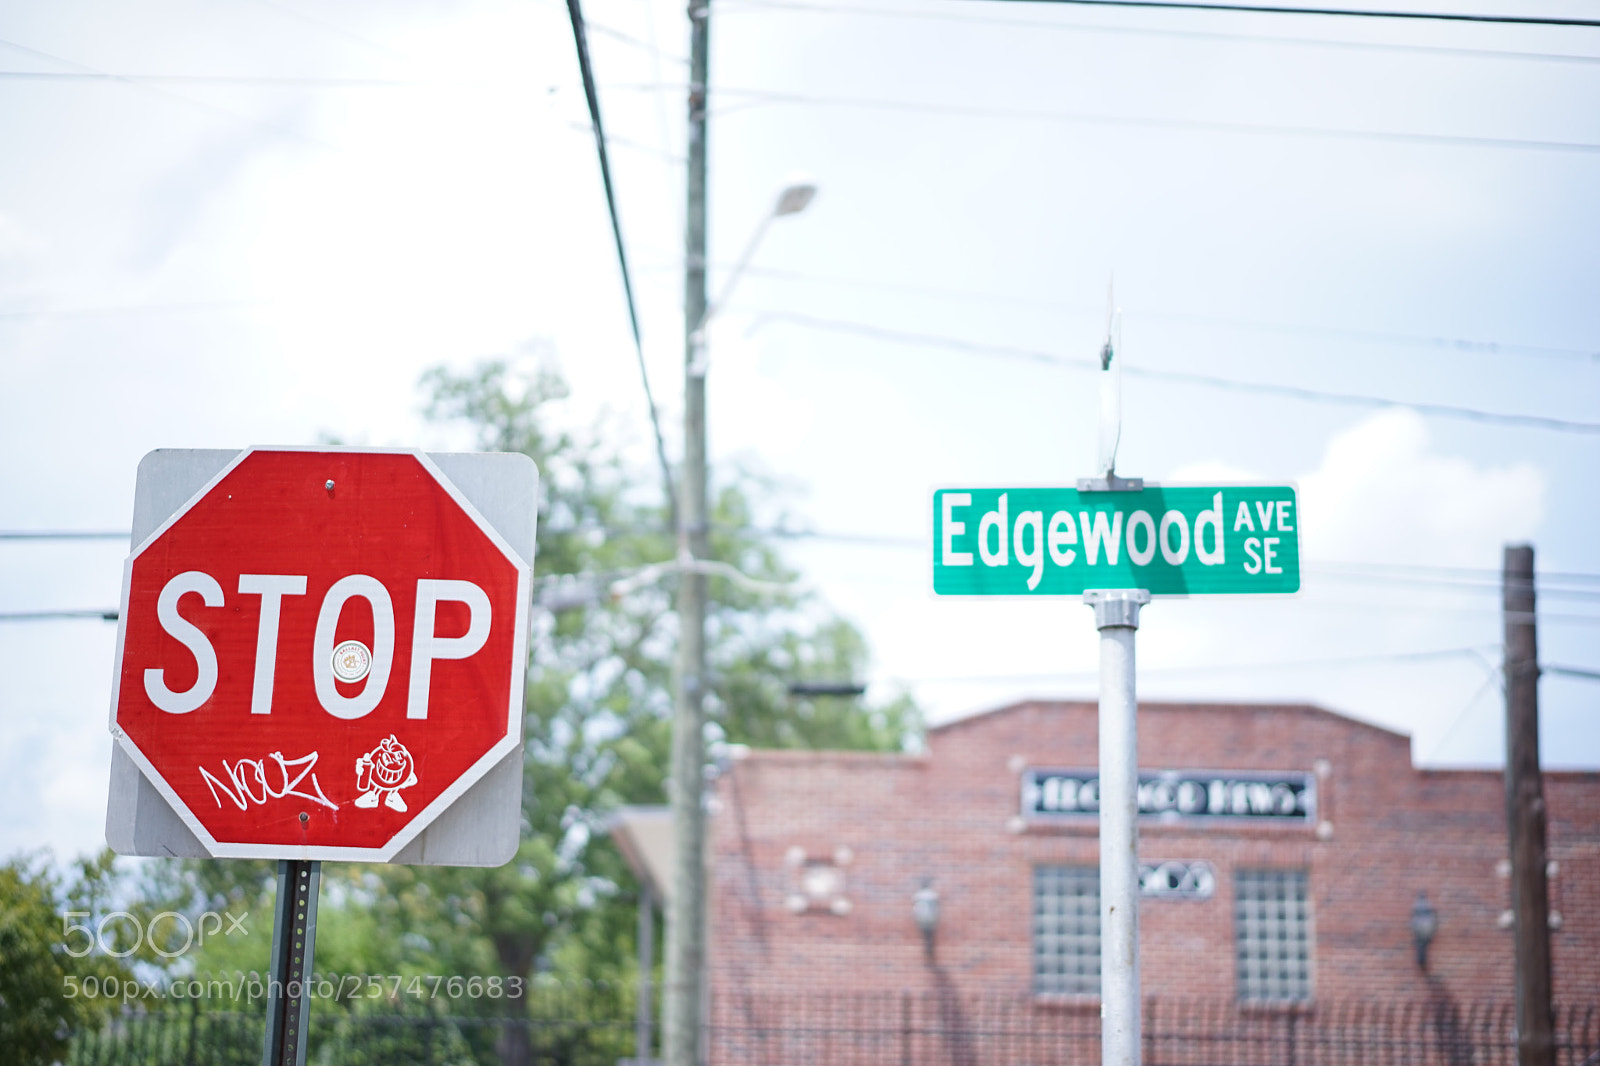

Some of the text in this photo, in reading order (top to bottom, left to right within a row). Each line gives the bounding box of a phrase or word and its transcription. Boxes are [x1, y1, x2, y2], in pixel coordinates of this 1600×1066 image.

[942, 491, 1294, 591] Edgewood AVE
[1243, 537, 1283, 575] SE
[143, 571, 493, 720] STOP
